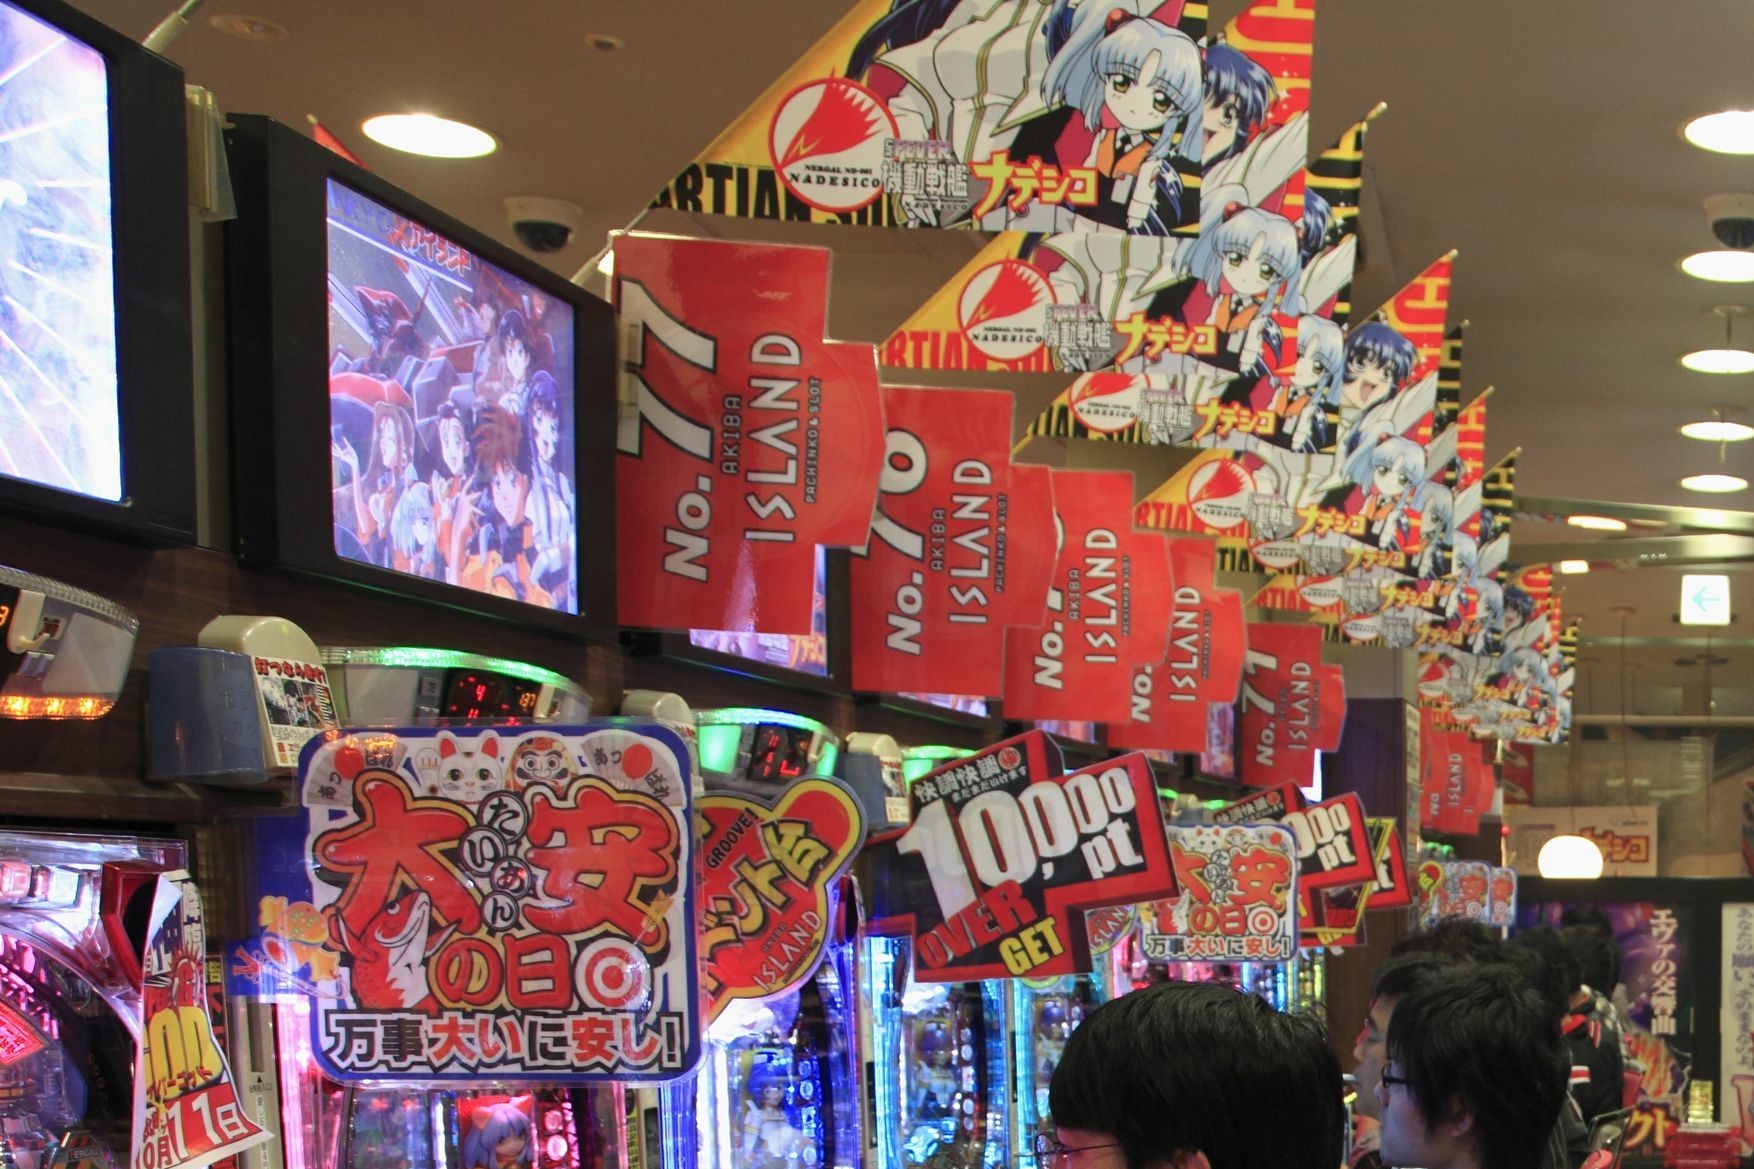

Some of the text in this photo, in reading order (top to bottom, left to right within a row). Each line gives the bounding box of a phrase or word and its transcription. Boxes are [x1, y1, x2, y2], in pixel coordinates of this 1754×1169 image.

[789, 173, 880, 189] NADESICO
[881, 161, 968, 197] 機動戦艦
[968, 150, 1098, 220] ナデシコ
[1113, 311, 1218, 366] ナデシコ
[720, 394, 743, 476] AKIBA
[743, 331, 803, 544] ISLAND
[1195, 397, 1276, 443] ナデシコ
[929, 508, 947, 571] AKIBA
[948, 457, 993, 625] ISLAND
[1084, 526, 1119, 664] ISLAND
[1169, 585, 1202, 702] ISLAND
[1287, 661, 1313, 751] ISLAND
[704, 808, 760, 871] GROOVE!
[896, 765, 1145, 924] 10,000 pt
[752, 907, 823, 992] ISLAND
[916, 880, 1038, 970] OVER
[999, 917, 1065, 976] GET
[434, 933, 575, 1011] の日
